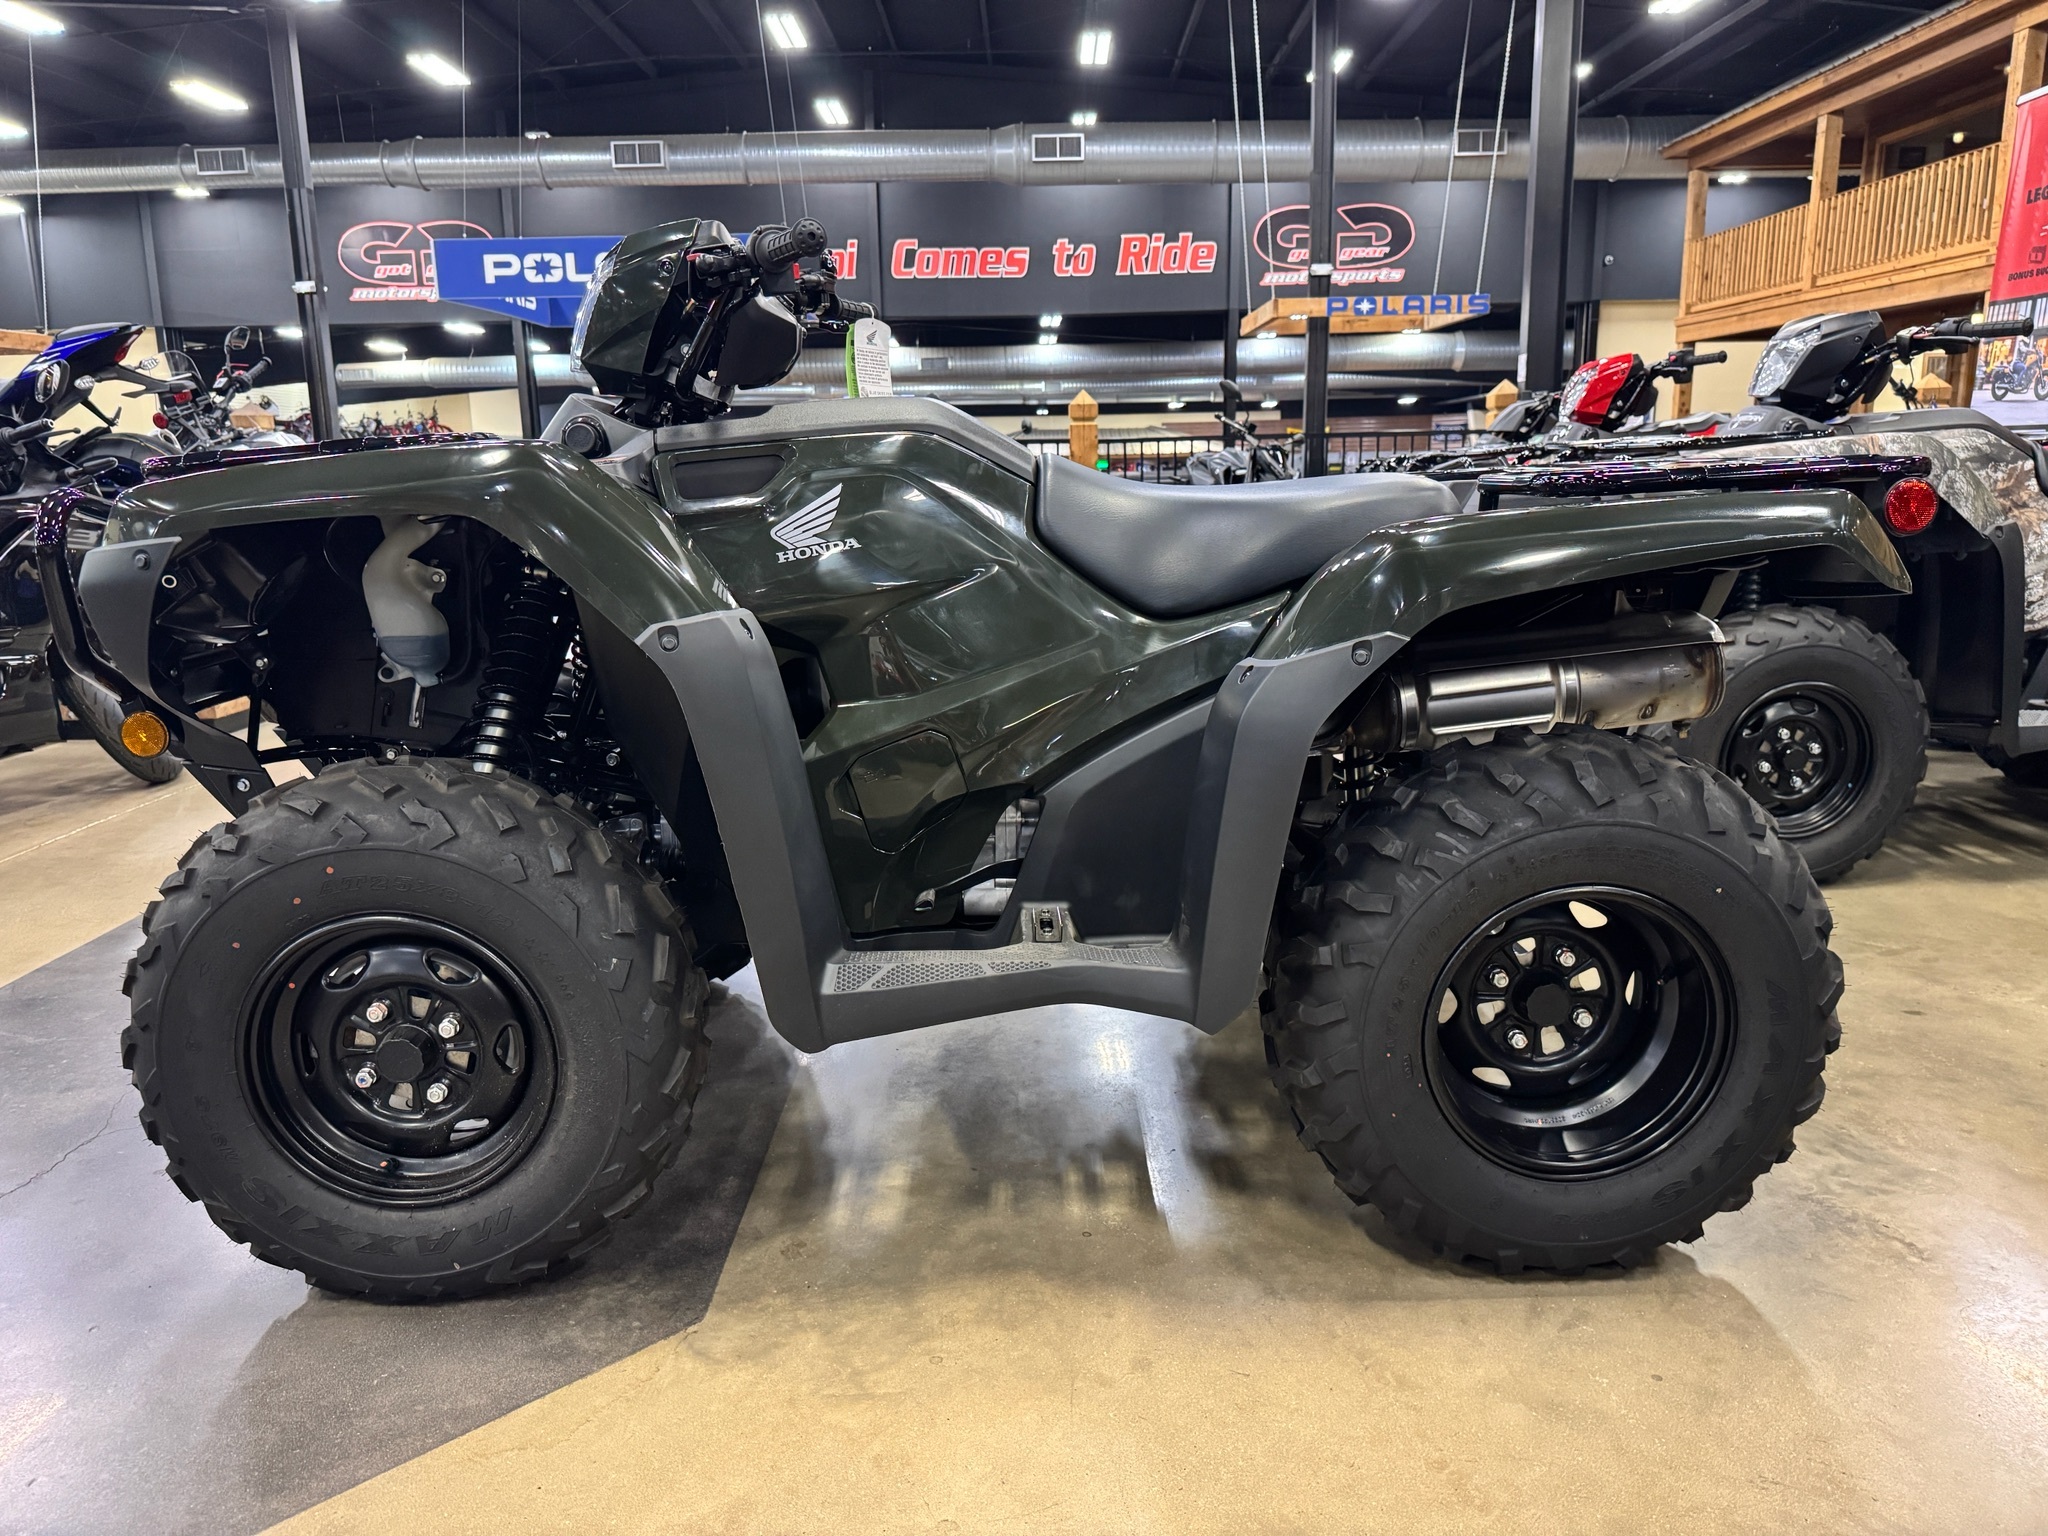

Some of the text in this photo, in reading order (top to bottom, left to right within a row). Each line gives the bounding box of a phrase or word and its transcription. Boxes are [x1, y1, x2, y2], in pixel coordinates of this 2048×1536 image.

[891, 238, 1030, 280] Comes
[1053, 237, 1097, 277] to
[1115, 232, 1218, 276] Ride
[1287, 246, 1391, 262] go gear
[374, 263, 412, 279] got
[1259, 267, 1406, 286] motsports
[2007, 268, 2035, 282] BONUS
[1326, 293, 1491, 317] POLARIS
[776, 537, 862, 564] HONDA
[240, 1175, 514, 1257] MAXXIS
